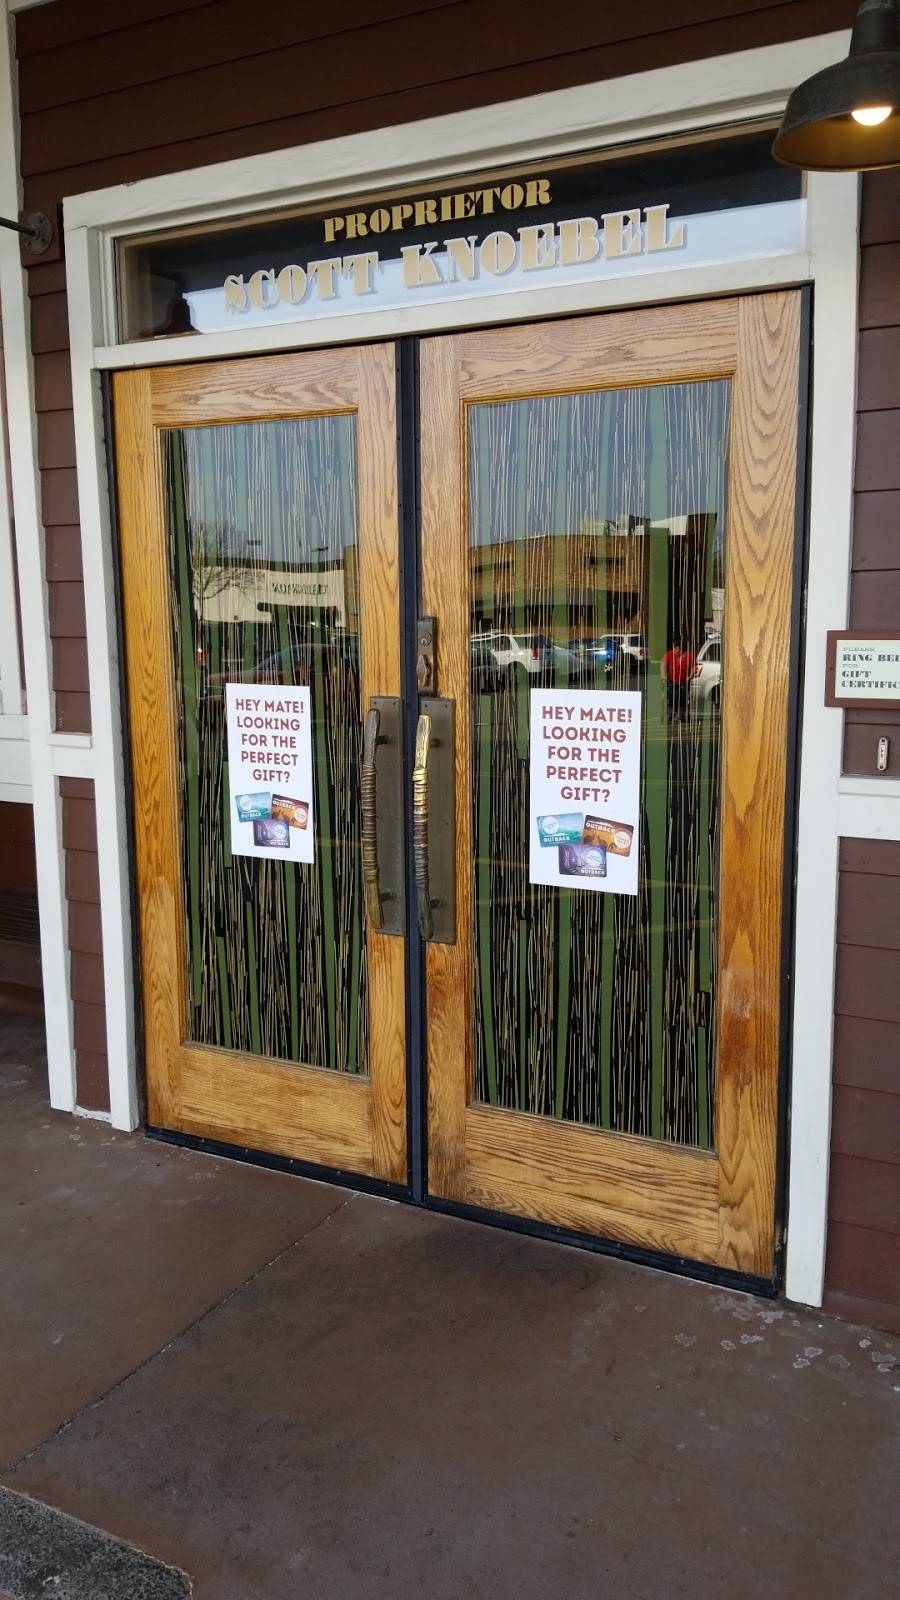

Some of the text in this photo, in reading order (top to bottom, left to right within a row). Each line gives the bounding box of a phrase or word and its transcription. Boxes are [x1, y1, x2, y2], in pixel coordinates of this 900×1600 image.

[323, 178, 552, 242] PROPRIETOR
[223, 203, 687, 315] SCOTT KNOEBEL
[235, 698, 304, 714] HEY MATE!
[542, 705, 633, 723] HEY MATE!
[236, 715, 301, 732] LOOKING
[241, 733, 297, 749] FOR THE
[542, 725, 627, 743] LOOKING
[241, 750, 298, 767] PERFECT
[547, 745, 620, 763] FOR THE
[252, 768, 291, 783] GIFT?
[546, 765, 623, 784] PERFECT
[560, 786, 611, 803] GIFT?
[586, 822, 616, 833] OUTBACK
[543, 835, 571, 843] OUTBACK
